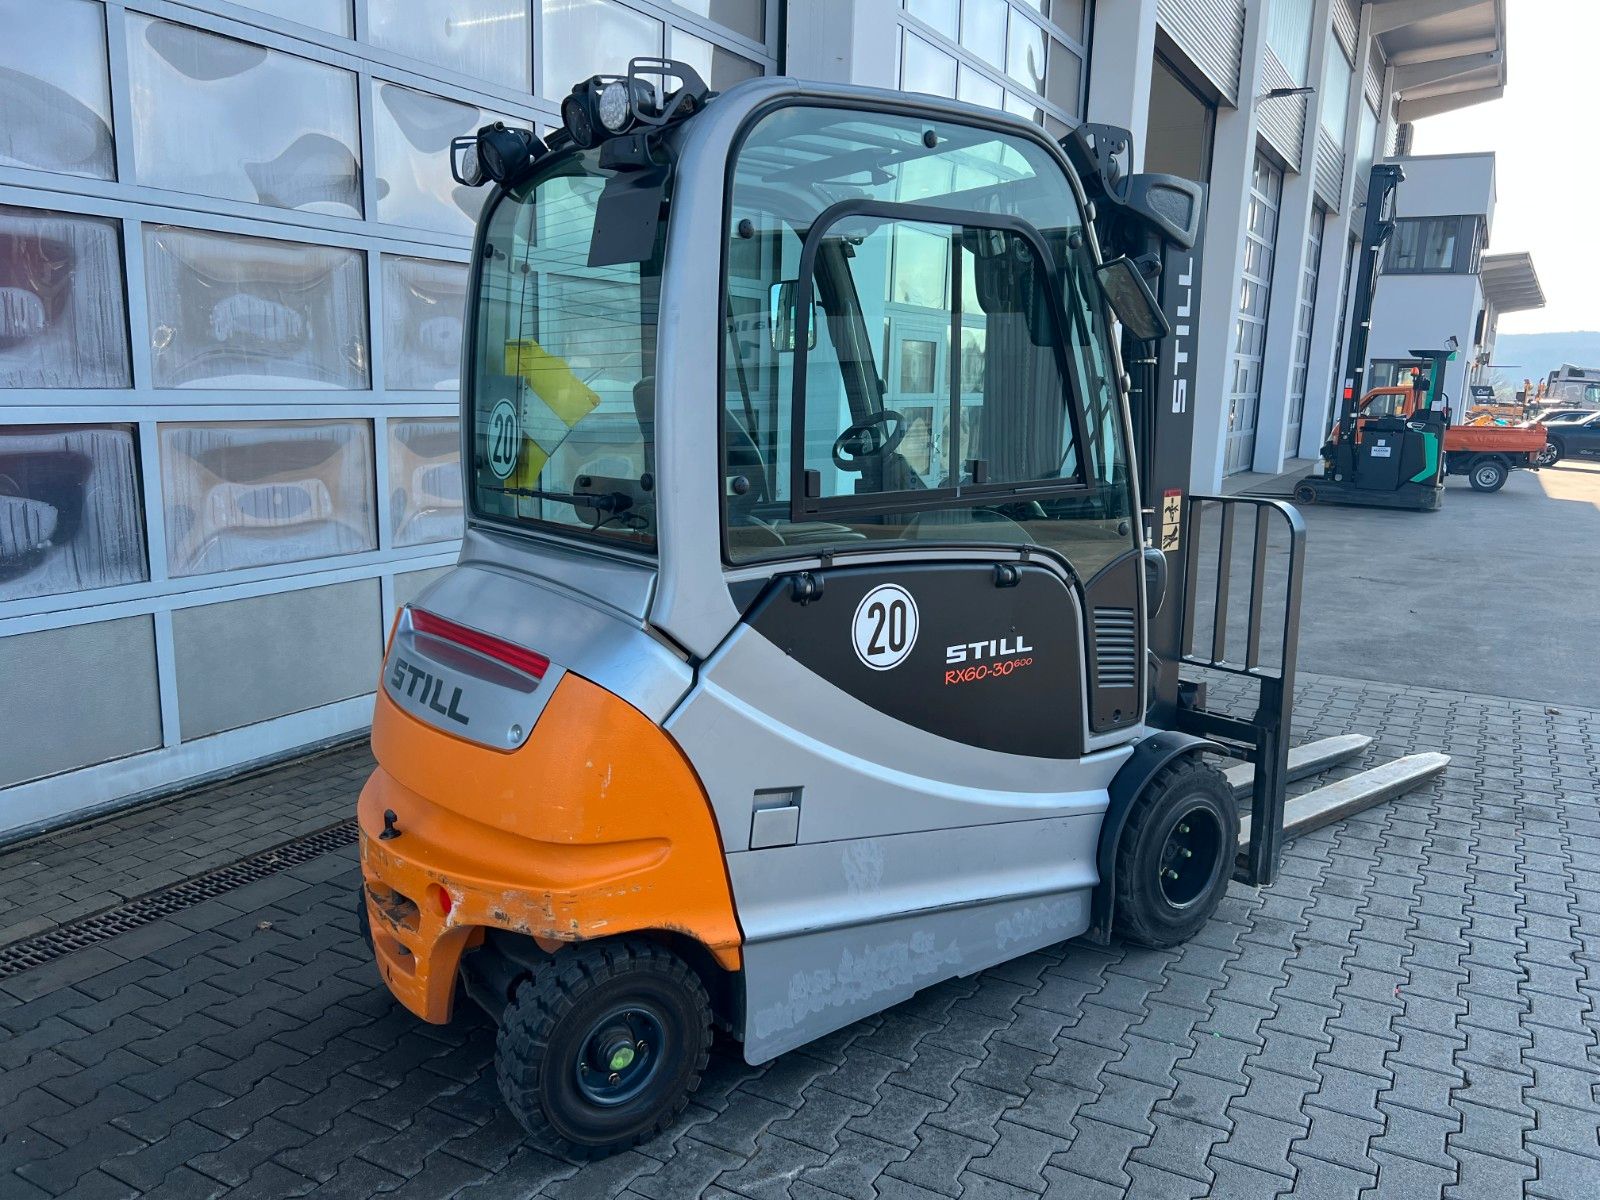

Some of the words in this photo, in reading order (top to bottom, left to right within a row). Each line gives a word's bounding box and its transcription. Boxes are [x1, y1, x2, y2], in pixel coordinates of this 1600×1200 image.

[1172, 257, 1193, 414] STILL
[493, 413, 514, 465] 20
[867, 599, 907, 656] 20
[945, 635, 1033, 664] STILL
[391, 656, 470, 726] STILL
